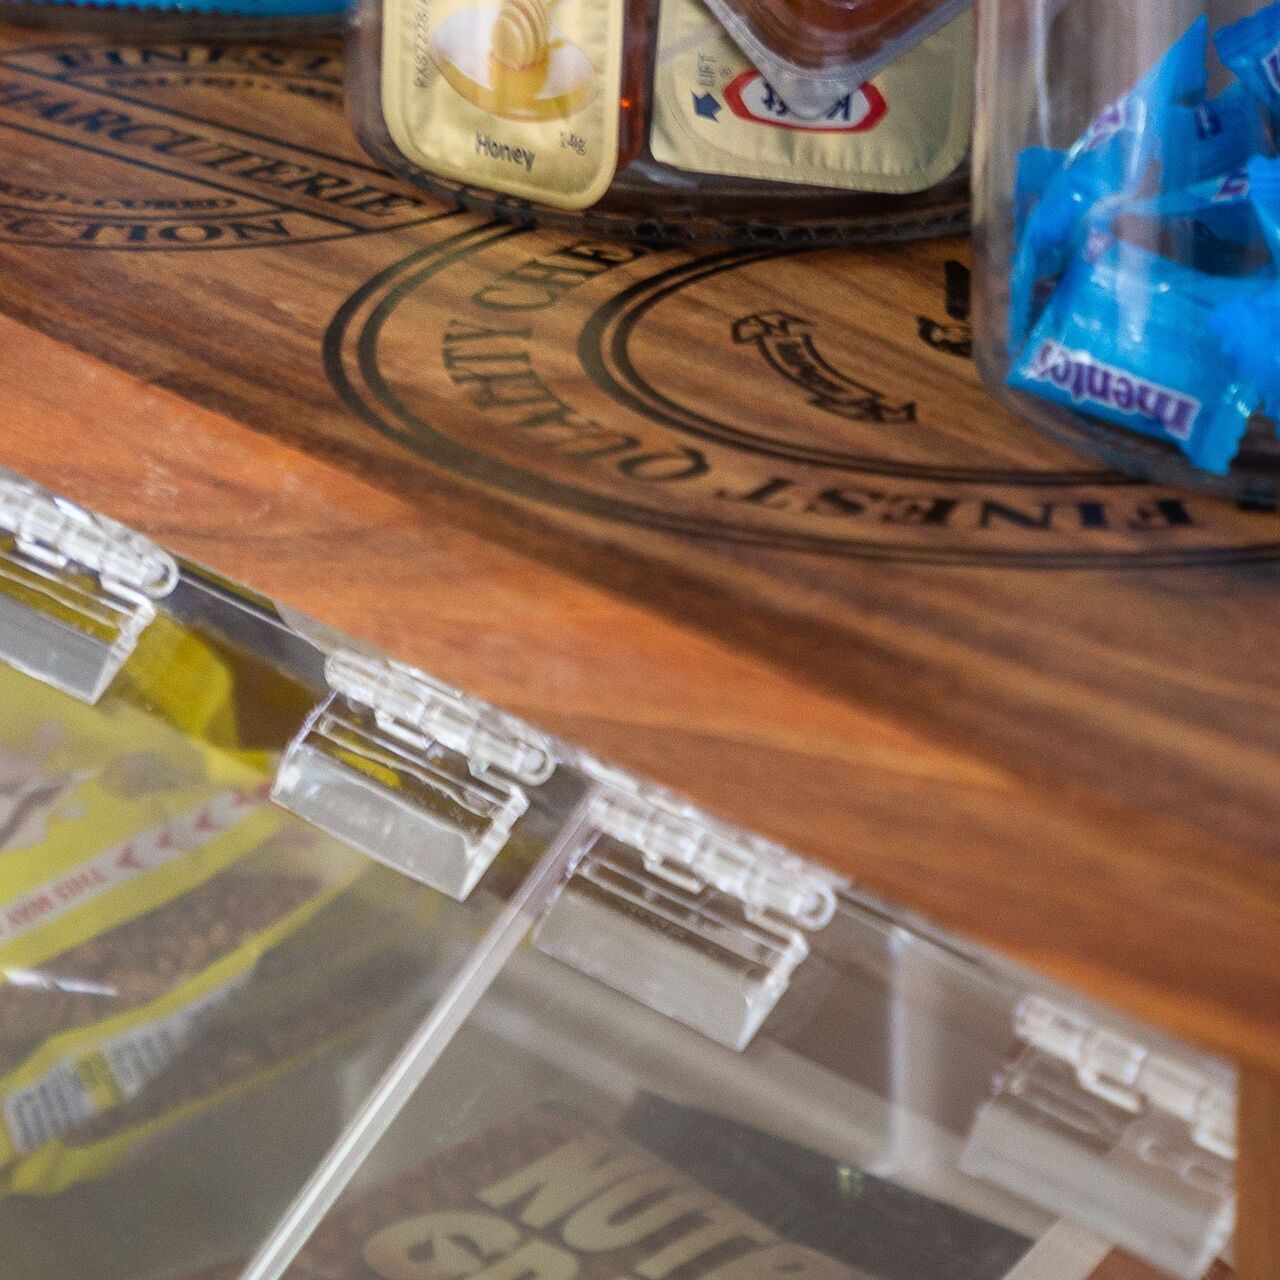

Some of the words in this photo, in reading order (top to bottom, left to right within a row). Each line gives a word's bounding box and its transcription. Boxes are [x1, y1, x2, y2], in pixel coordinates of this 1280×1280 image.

[697, 50, 717, 88] LIFT
[474, 128, 536, 172] Honey
[441, 317, 712, 483] QUALITY
[715, 476, 1199, 530] FINEST
[53, 869, 106, 901] THIS
[6, 894, 54, 925] WAY
